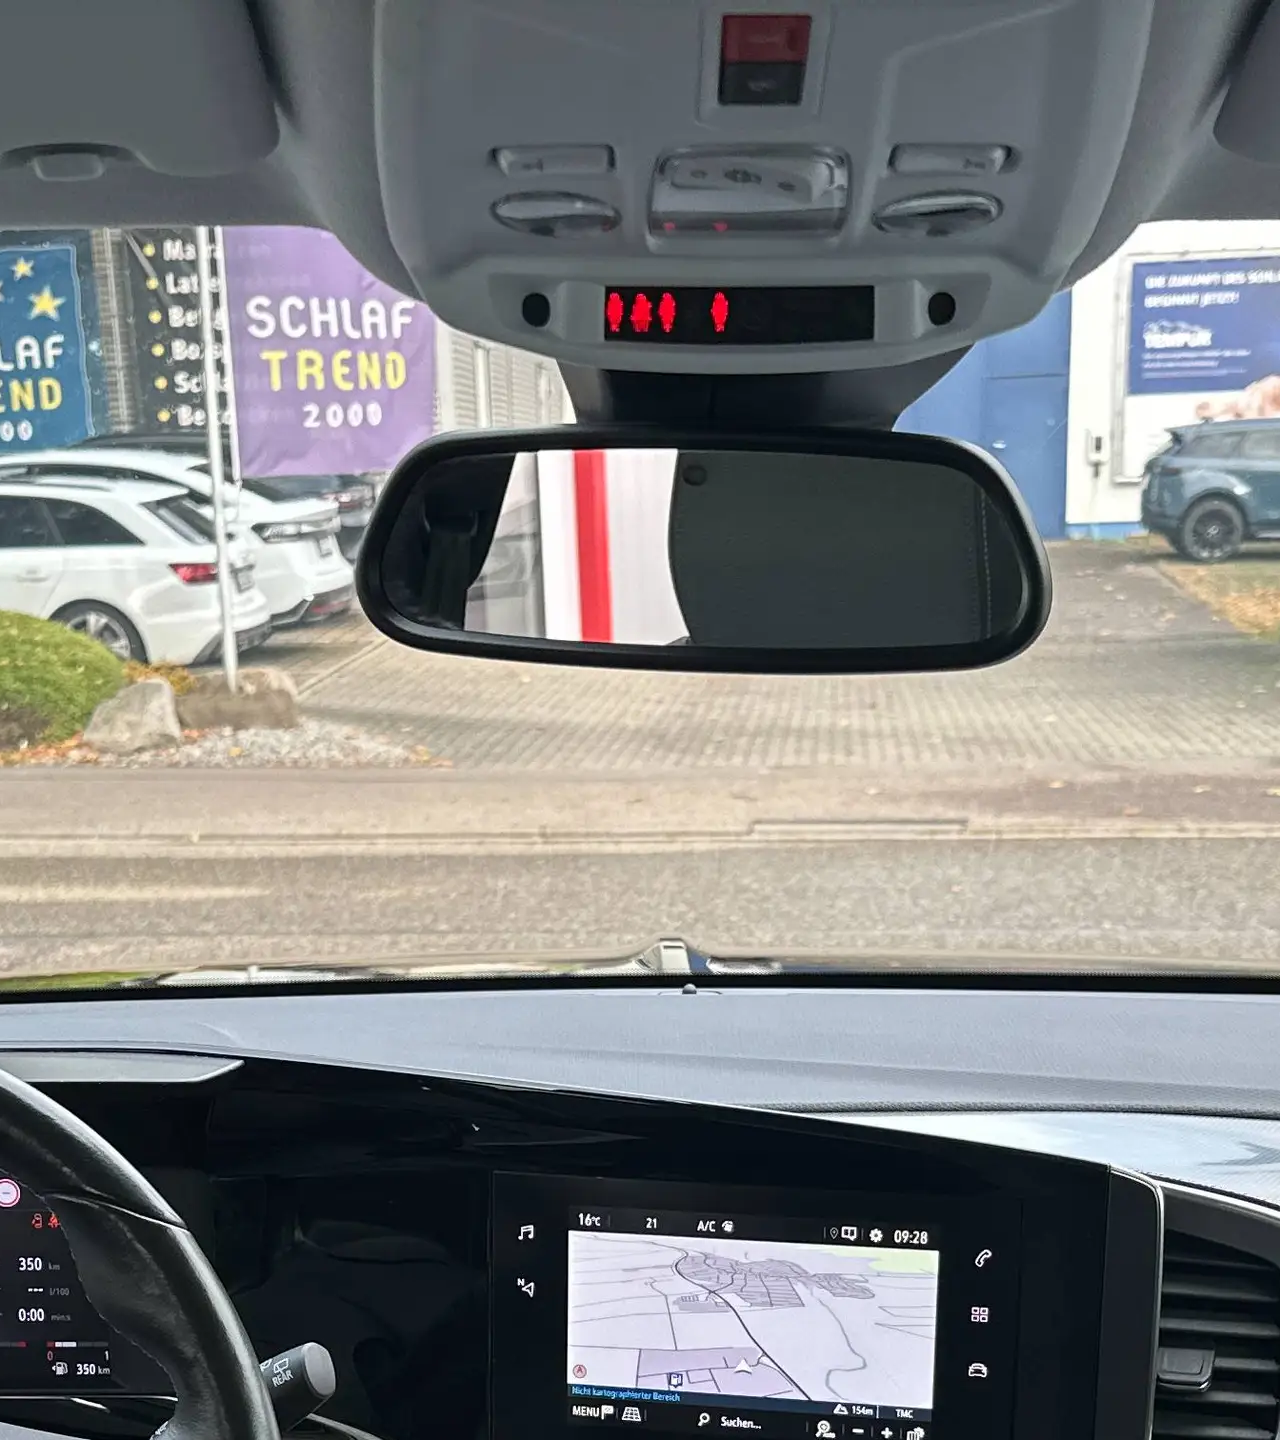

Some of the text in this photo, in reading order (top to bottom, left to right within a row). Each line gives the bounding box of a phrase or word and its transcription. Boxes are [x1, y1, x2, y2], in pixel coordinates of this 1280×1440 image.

[246, 295, 416, 339] SCHLAF
[259, 349, 407, 391] TREND
[302, 402, 383, 428] 2000
[646, 1217, 657, 1229] 21
[697, 1220, 716, 1233] A/C
[894, 1229, 928, 1244] 09:28
[18, 1257, 42, 1271] 350
[18, 1308, 45, 1322] 0:00
[47, 1351, 53, 1361] 0
[104, 1350, 110, 1361] 1
[76, 1363, 111, 1375] 350 km
[272, 1369, 294, 1387] REAR
[653, 1392, 680, 1402] Bereich
[572, 1405, 600, 1417] MENU
[852, 1405, 873, 1415] 154m
[895, 1408, 913, 1418] TMC
[720, 1416, 761, 1430] Suchen...
